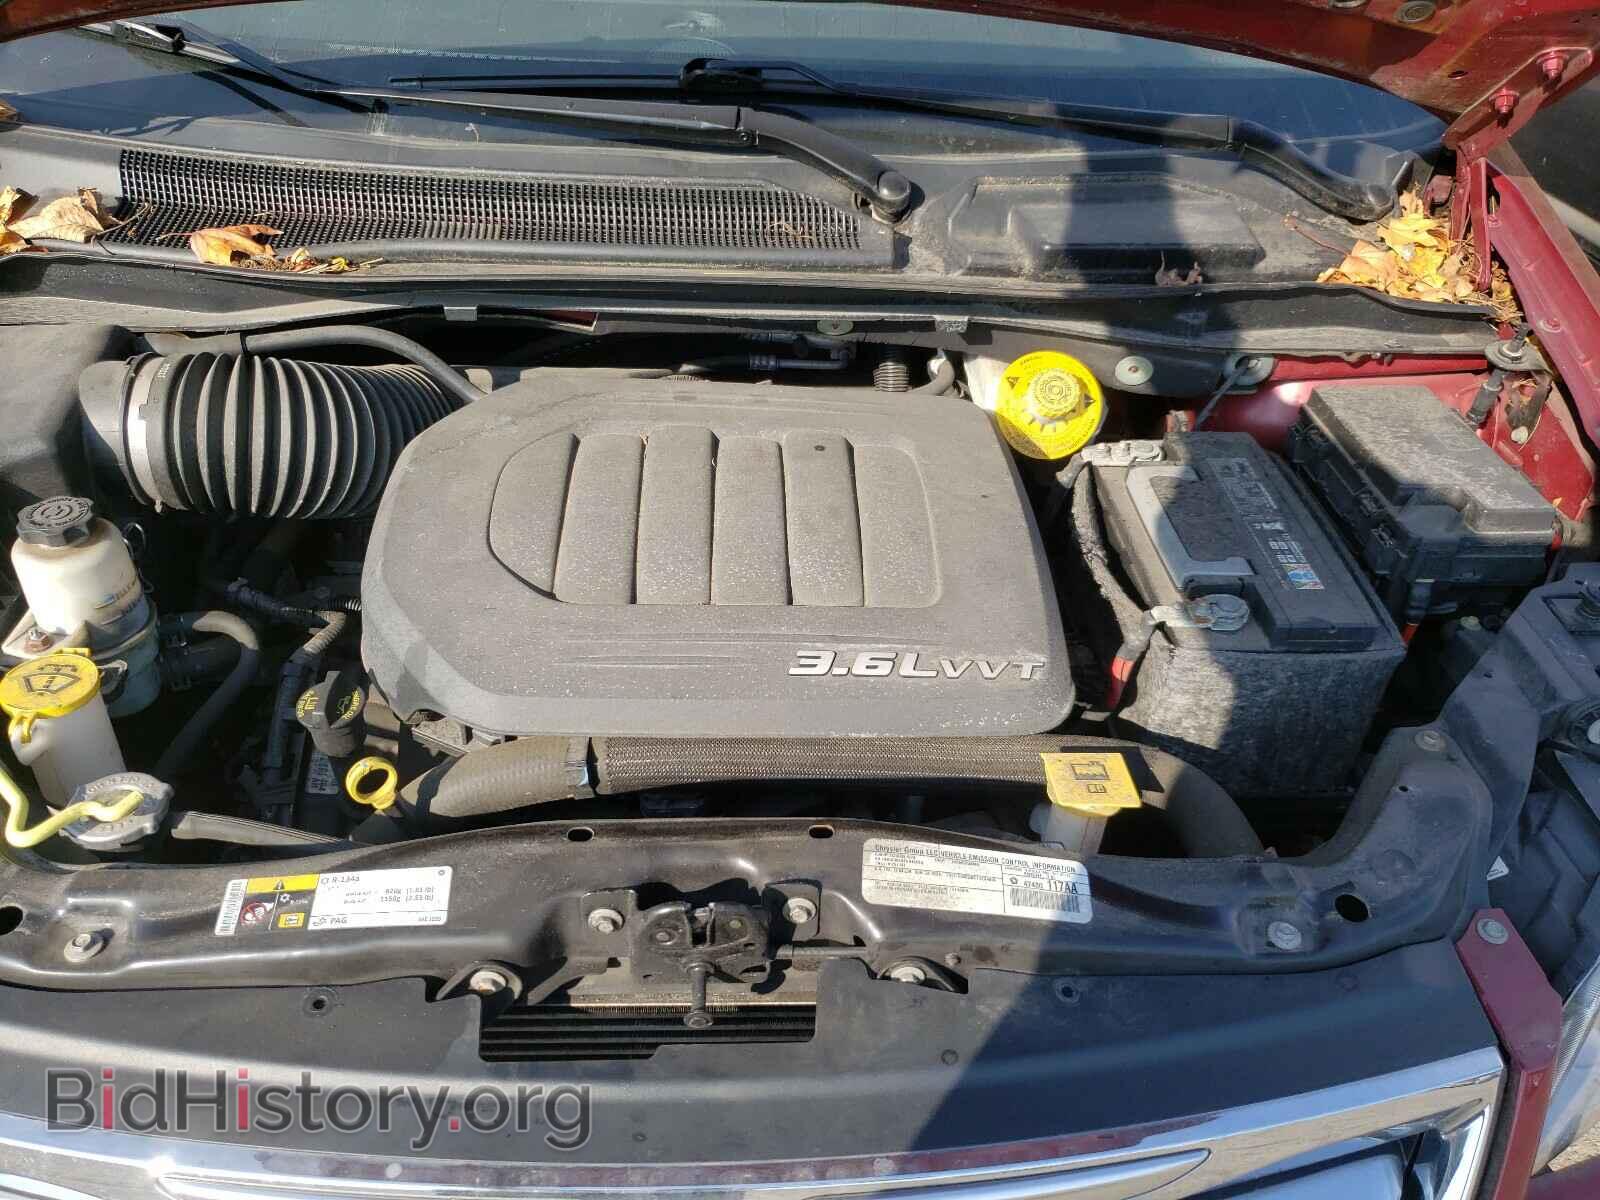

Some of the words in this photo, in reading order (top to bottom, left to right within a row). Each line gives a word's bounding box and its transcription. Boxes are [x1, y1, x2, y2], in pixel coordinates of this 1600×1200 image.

[788, 650, 938, 677] 3.6L
[940, 658, 1045, 679] VVT
[874, 844, 902, 854] Chrysler
[904, 846, 924, 856] Group
[926, 848, 939, 857] LLC
[940, 850, 967, 859] VEHICLE
[968, 853, 999, 863] EMISSION
[1001, 857, 1029, 867] CONTROL
[1032, 860, 1076, 872] INFORMATION
[330, 917, 348, 925] PAG
